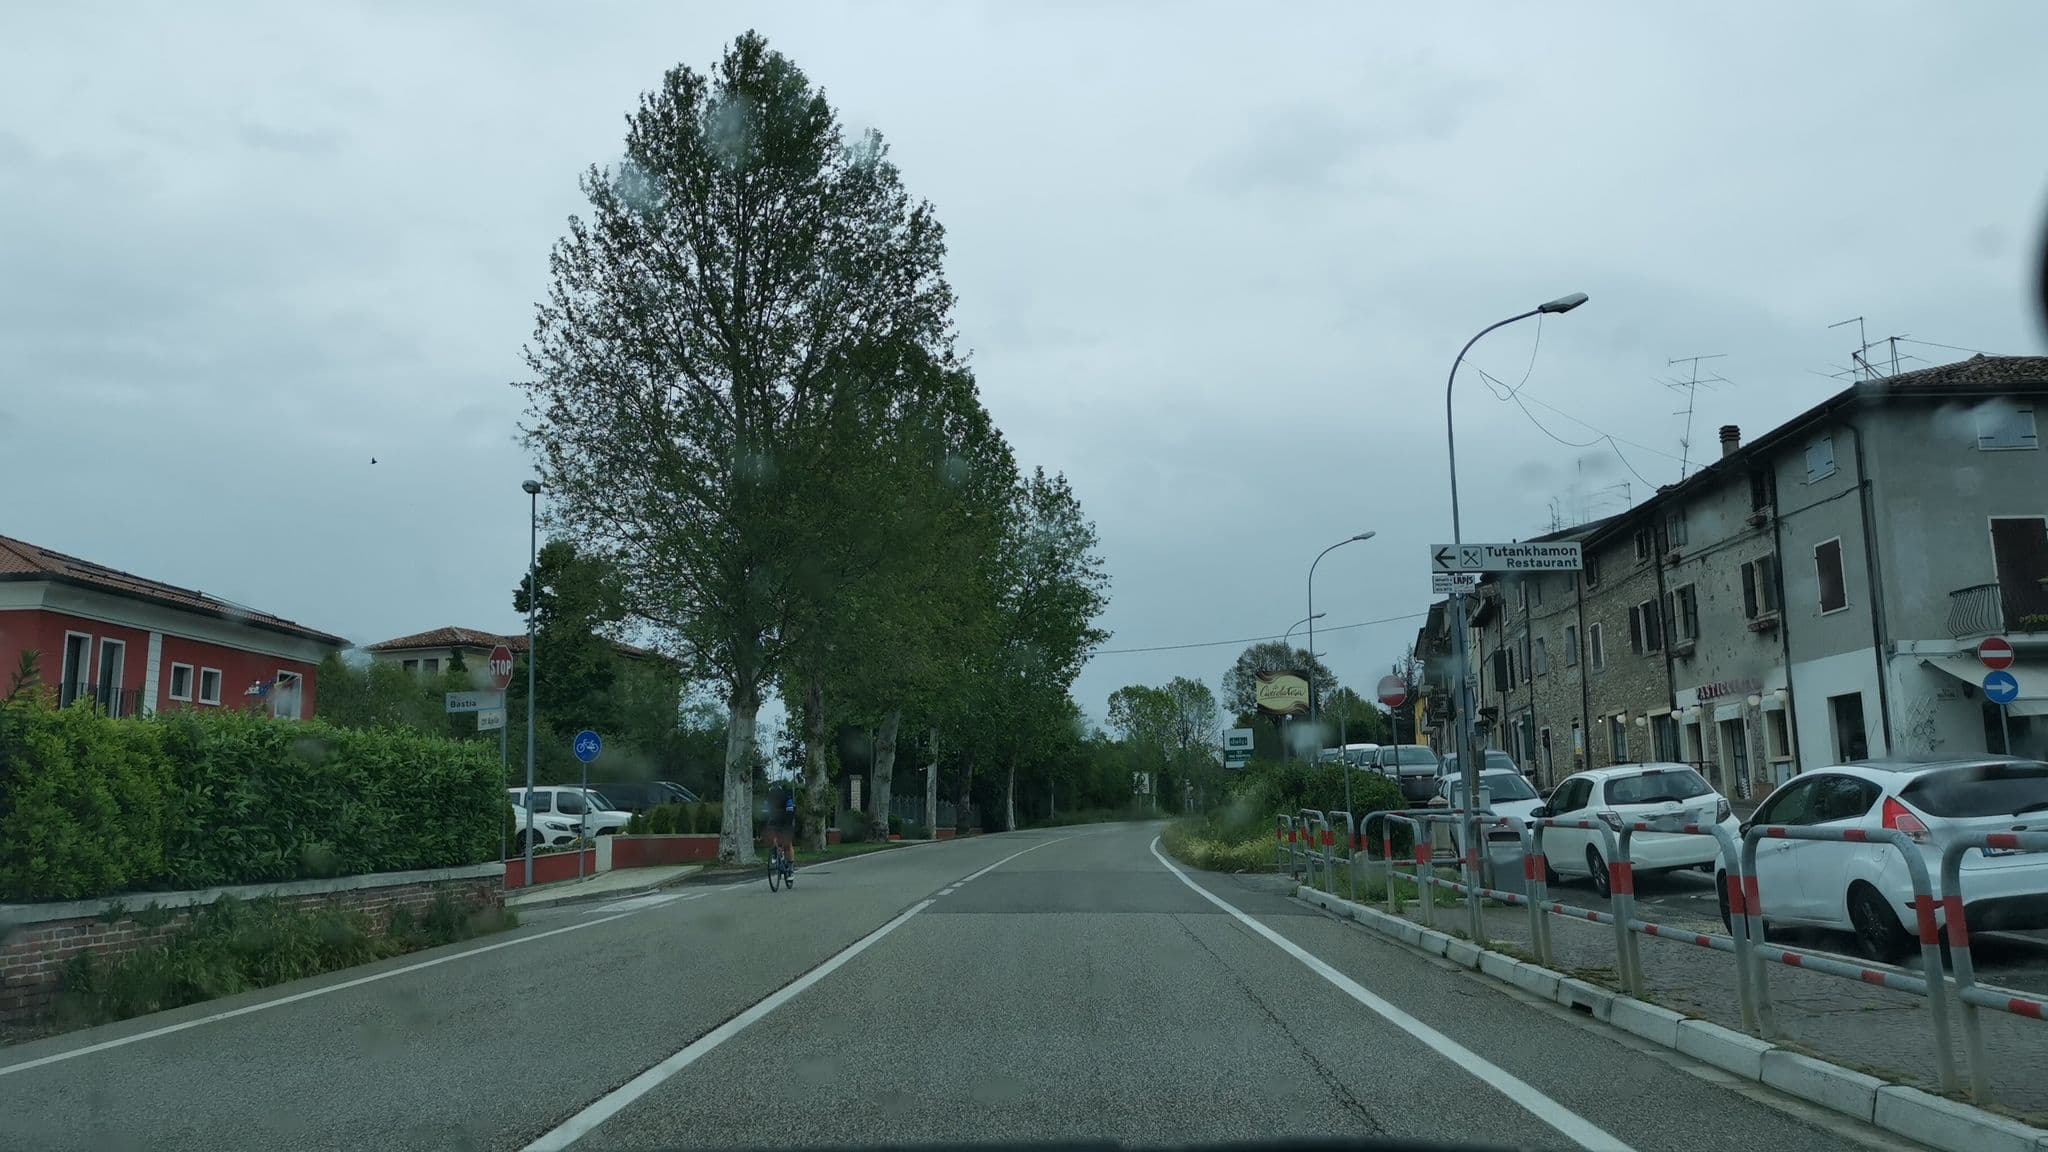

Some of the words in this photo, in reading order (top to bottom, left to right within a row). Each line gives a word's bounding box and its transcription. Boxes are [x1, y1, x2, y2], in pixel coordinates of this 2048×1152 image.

[1486, 545, 1578, 557] Tutankhamon
[1506, 557, 1578, 568] Restaurant
[490, 659, 511, 676] STOP
[450, 699, 477, 708] Bastia
